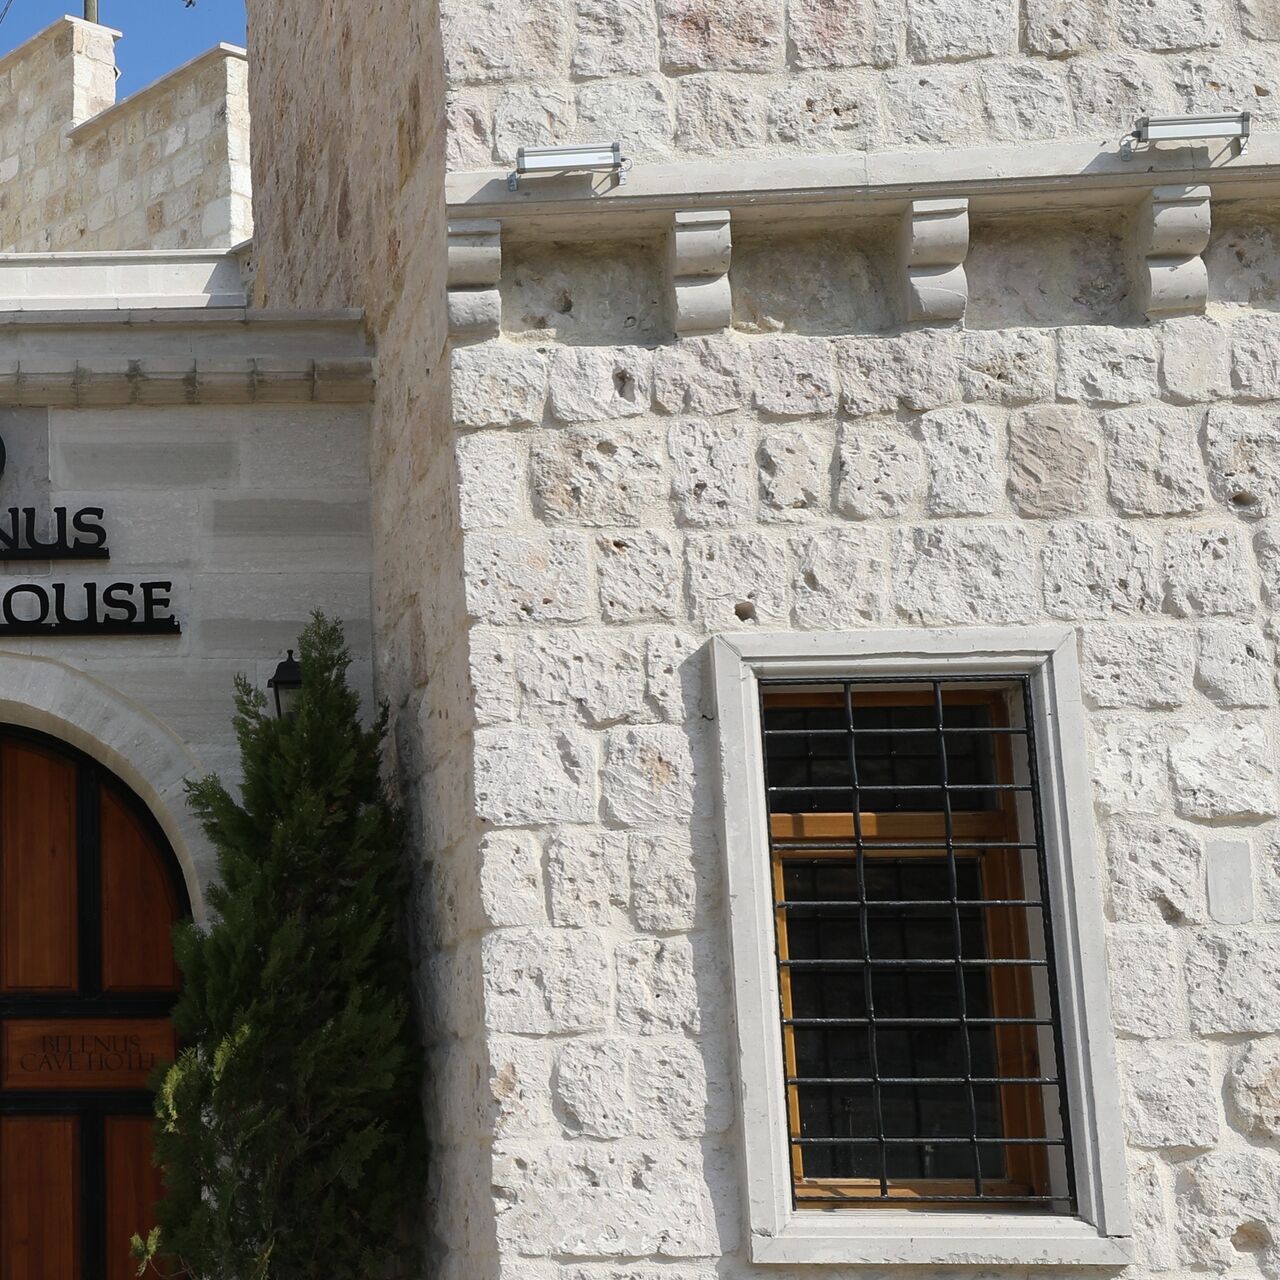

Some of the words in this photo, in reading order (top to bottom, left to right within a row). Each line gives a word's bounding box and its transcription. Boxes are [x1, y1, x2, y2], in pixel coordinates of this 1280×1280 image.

[41, 1034, 141, 1053] BELENUS
[19, 1052, 81, 1072] CAVE
[87, 1051, 160, 1071] HOTEL
